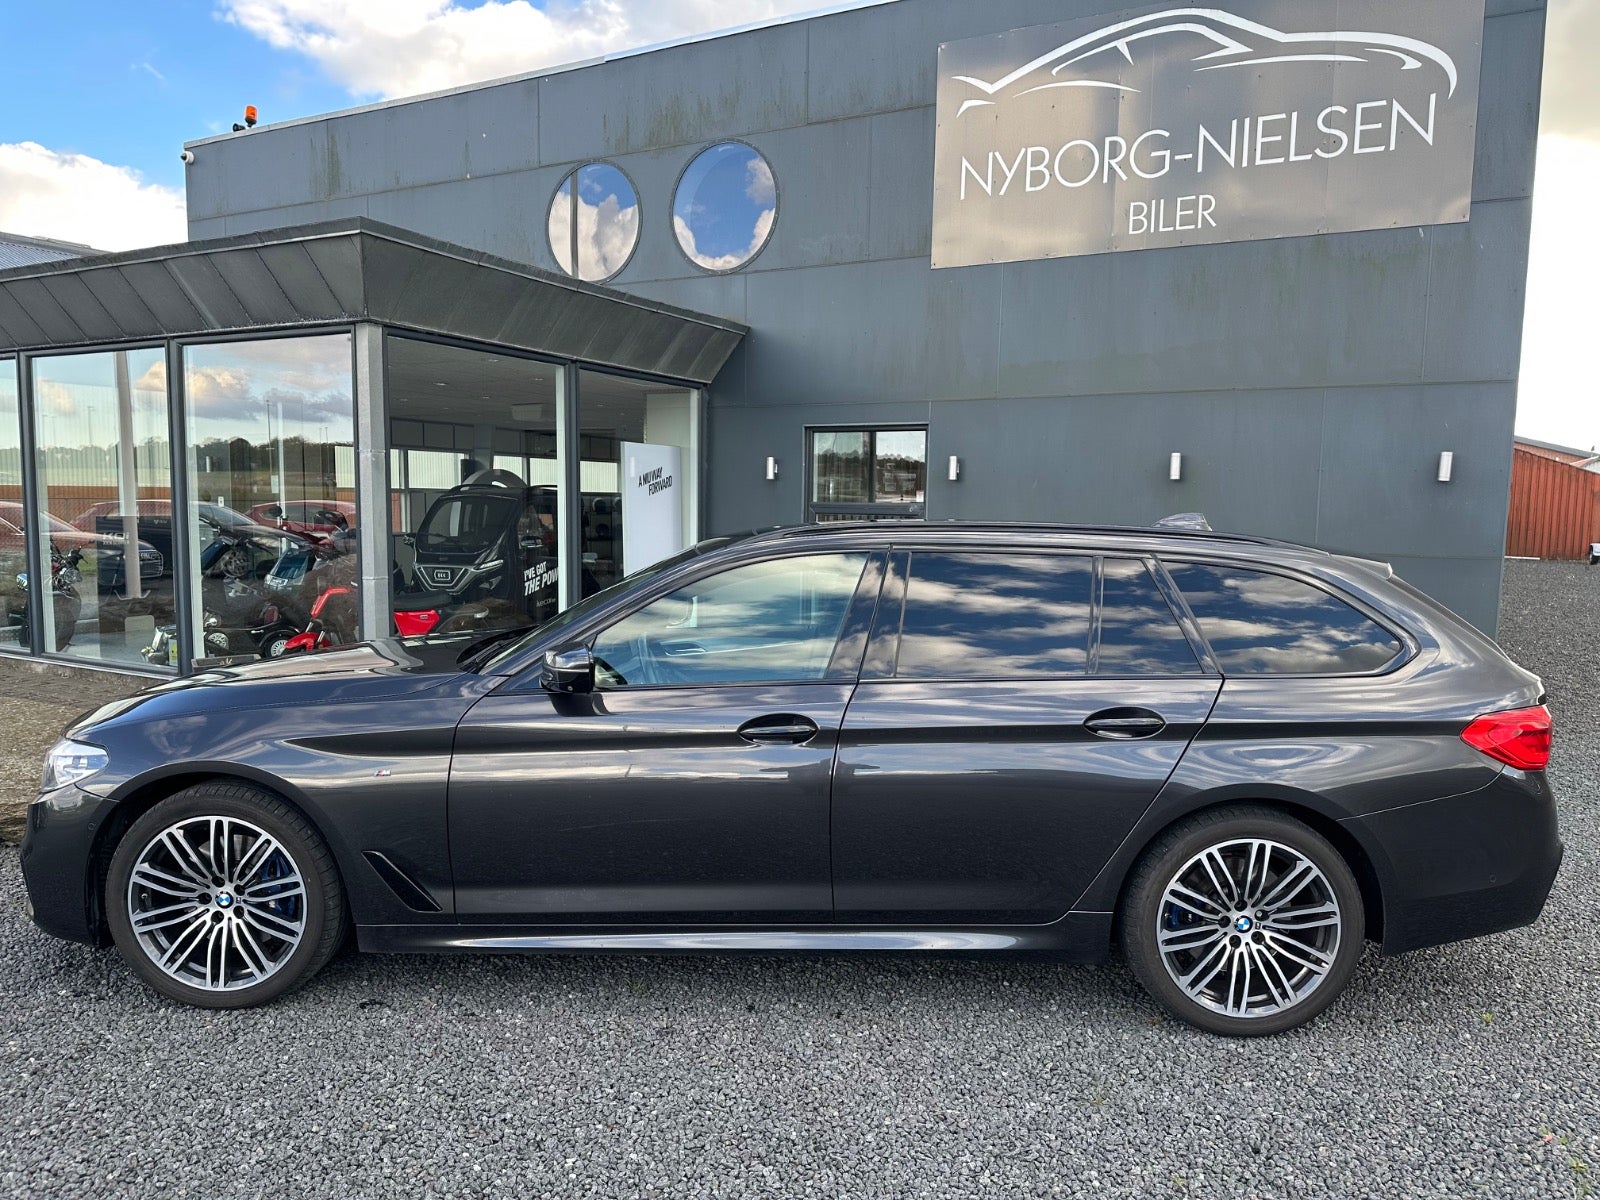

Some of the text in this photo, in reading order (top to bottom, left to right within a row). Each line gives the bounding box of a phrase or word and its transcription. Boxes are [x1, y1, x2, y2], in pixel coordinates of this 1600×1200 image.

[960, 93, 1437, 200] NYBORG-NIELSEN
[1128, 194, 1217, 235] BILER
[638, 475, 643, 488] A
[648, 475, 673, 496] FORWARD
[523, 561, 547, 581] I'VE GOT
[525, 575, 541, 597] THE
